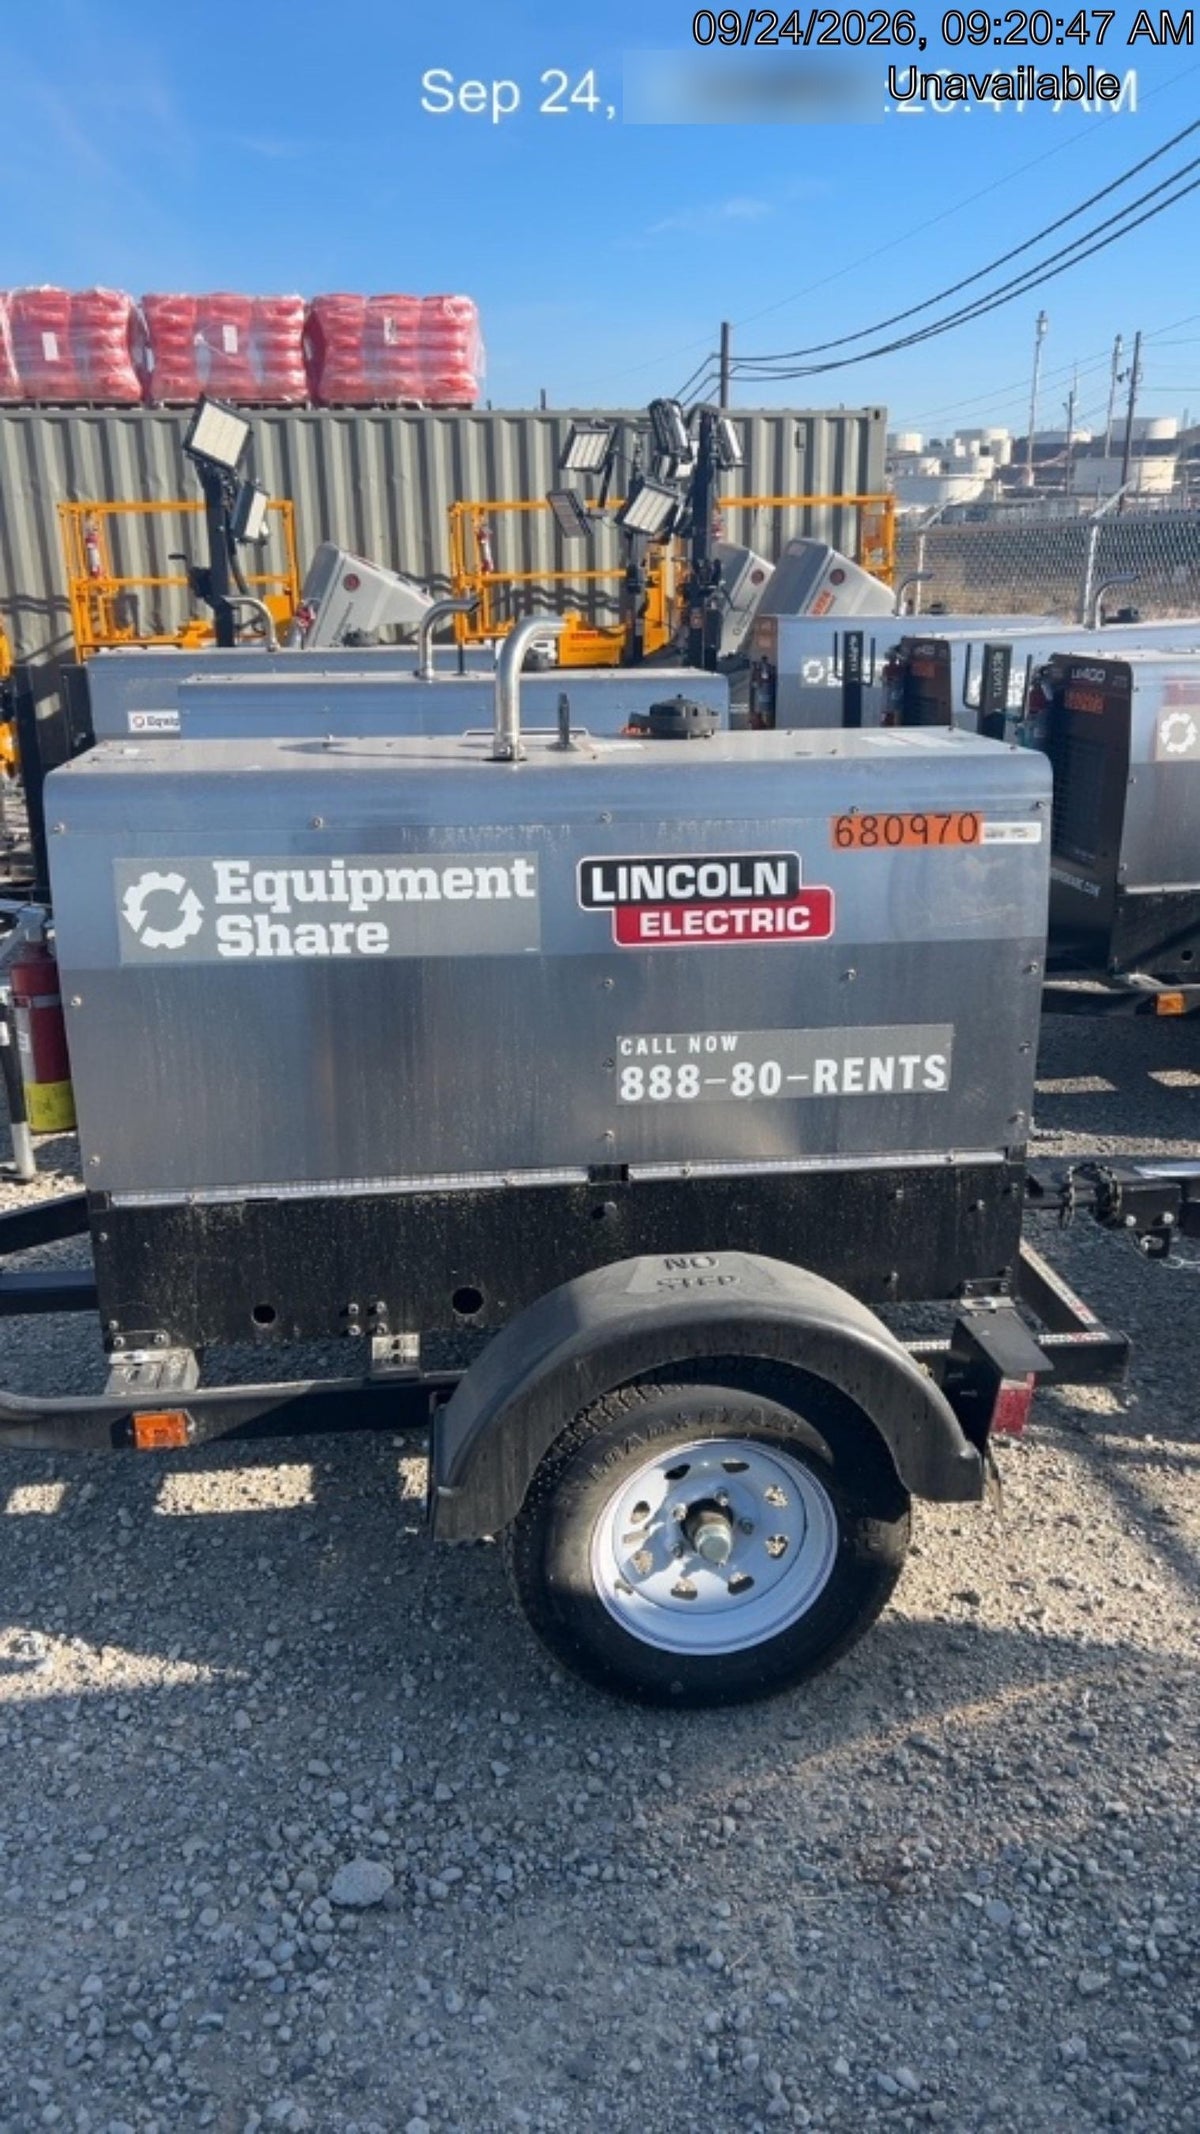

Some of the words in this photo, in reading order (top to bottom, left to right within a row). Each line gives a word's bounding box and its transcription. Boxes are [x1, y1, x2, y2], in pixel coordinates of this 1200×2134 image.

[834, 813, 979, 847] 680970
[213, 858, 535, 912] Equipment
[591, 862, 789, 901] LINCOLN
[216, 914, 390, 957] Share
[639, 906, 811, 938] ELECTRIC
[620, 1038, 678, 1056] CALL
[688, 1036, 738, 1054] NOW
[619, 1054, 947, 1101] 888-80-RENTS
[664, 1256, 717, 1271] NO
